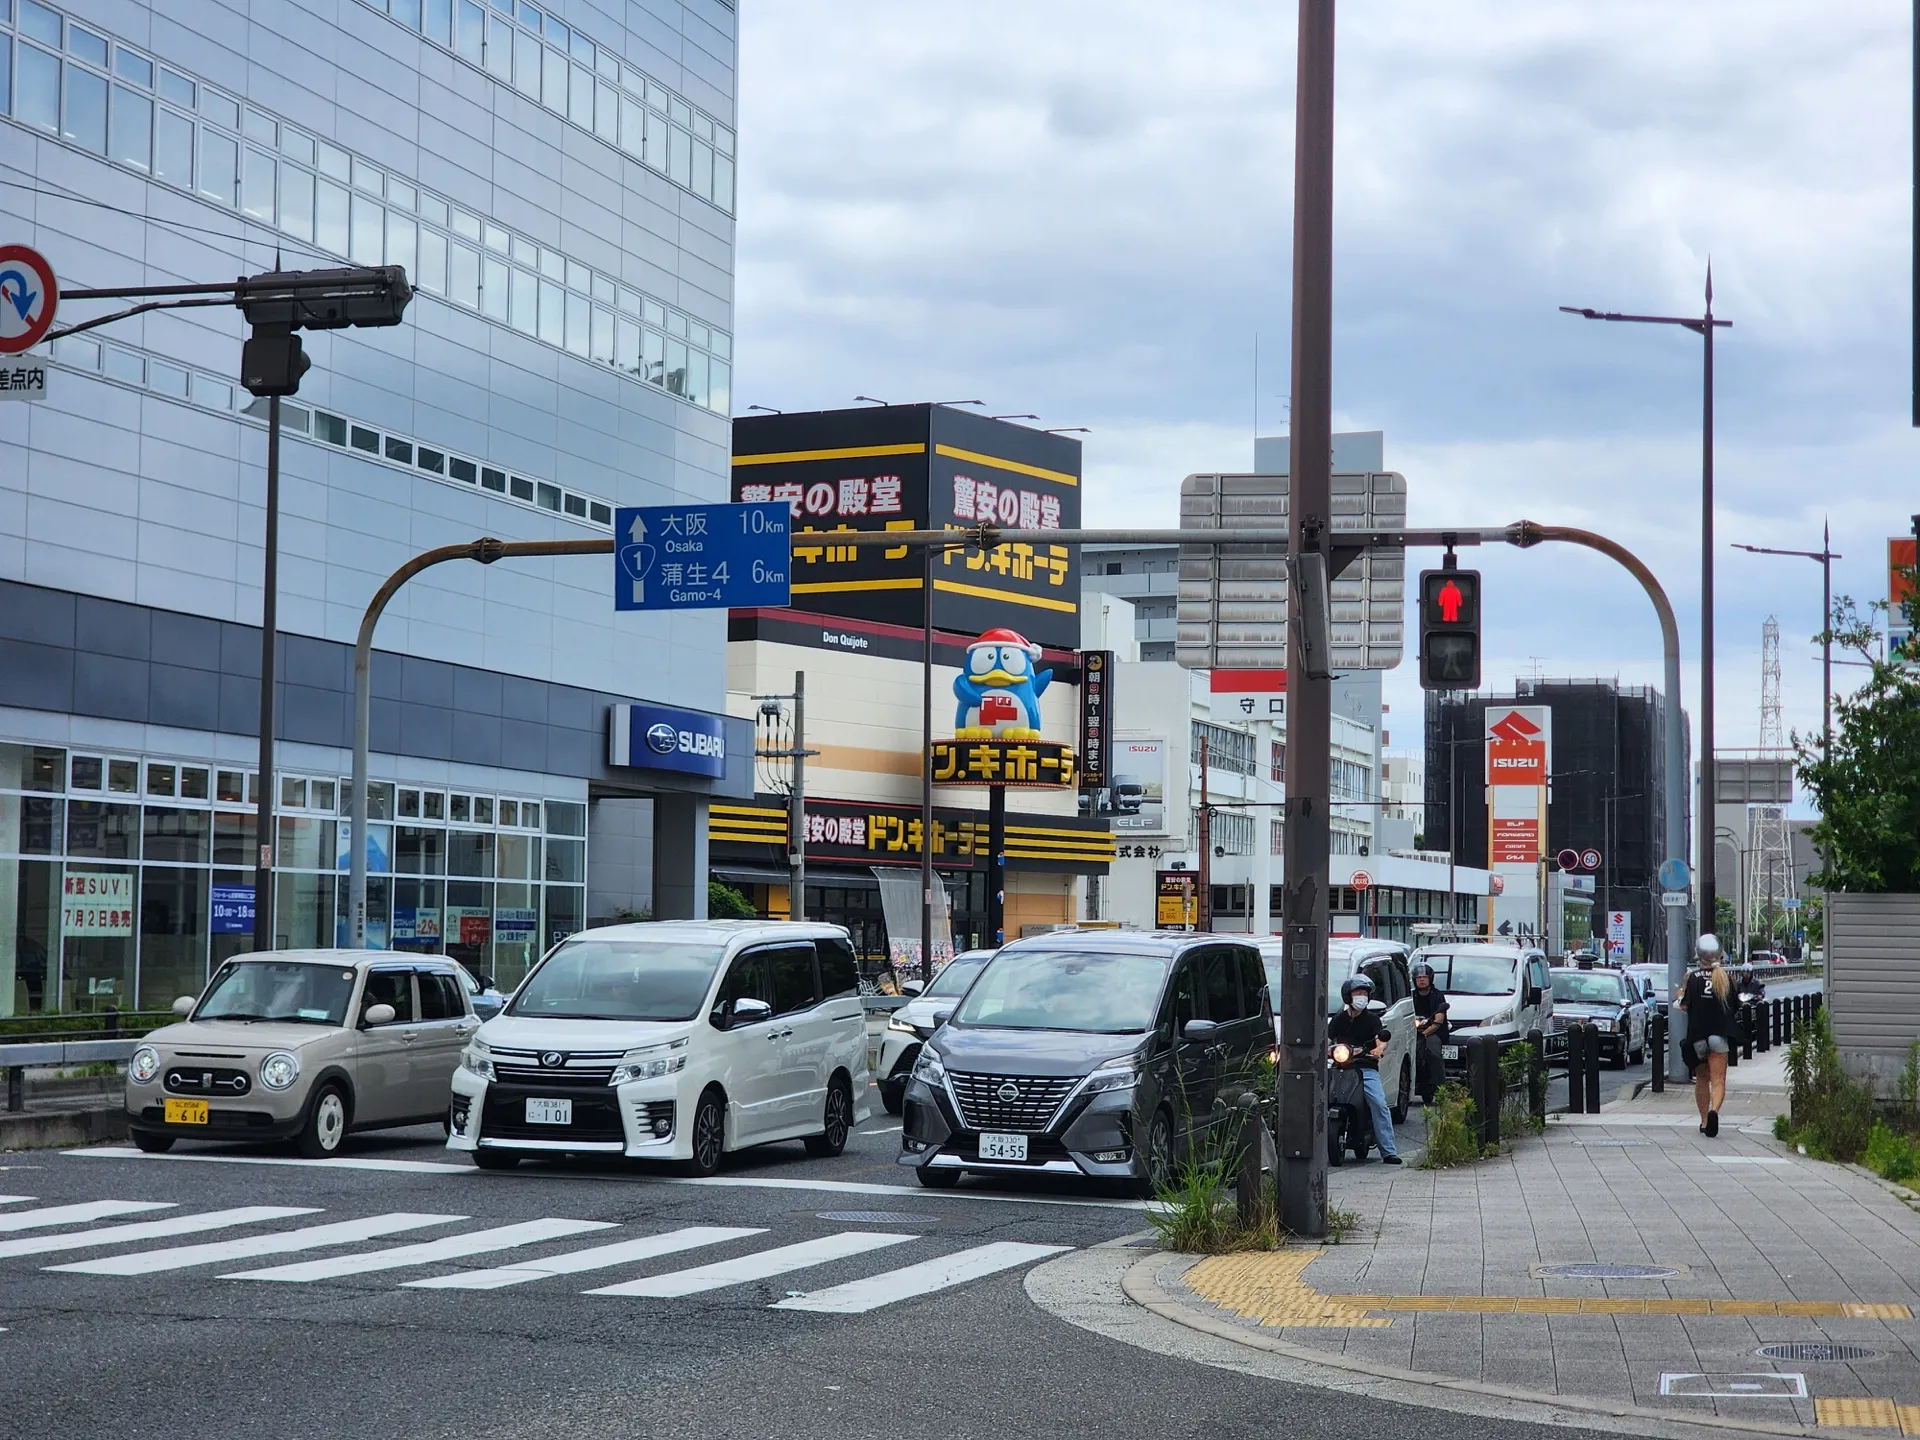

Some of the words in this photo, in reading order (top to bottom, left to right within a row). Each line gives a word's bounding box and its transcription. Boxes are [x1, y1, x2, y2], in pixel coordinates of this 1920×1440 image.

[660, 512, 709, 537] 大阪
[665, 540, 704, 553] Osaka
[633, 550, 642, 571] 1
[660, 560, 731, 586] 蒲生4
[751, 559, 785, 584] 6Km
[669, 588, 722, 603] Gamo-4
[823, 631, 839, 644] Don
[840, 634, 868, 650] Quijote
[678, 731, 725, 758] SUBARU
[1128, 745, 1158, 753] ISUZU
[1493, 758, 1538, 768] ISUZU
[1116, 818, 1154, 828] ELF
[1584, 855, 1597, 864] 60
[64, 908, 132, 928] 7月2日発売
[1518, 922, 1534, 935] IN
[989, 1144, 1025, 1159] 54-55
